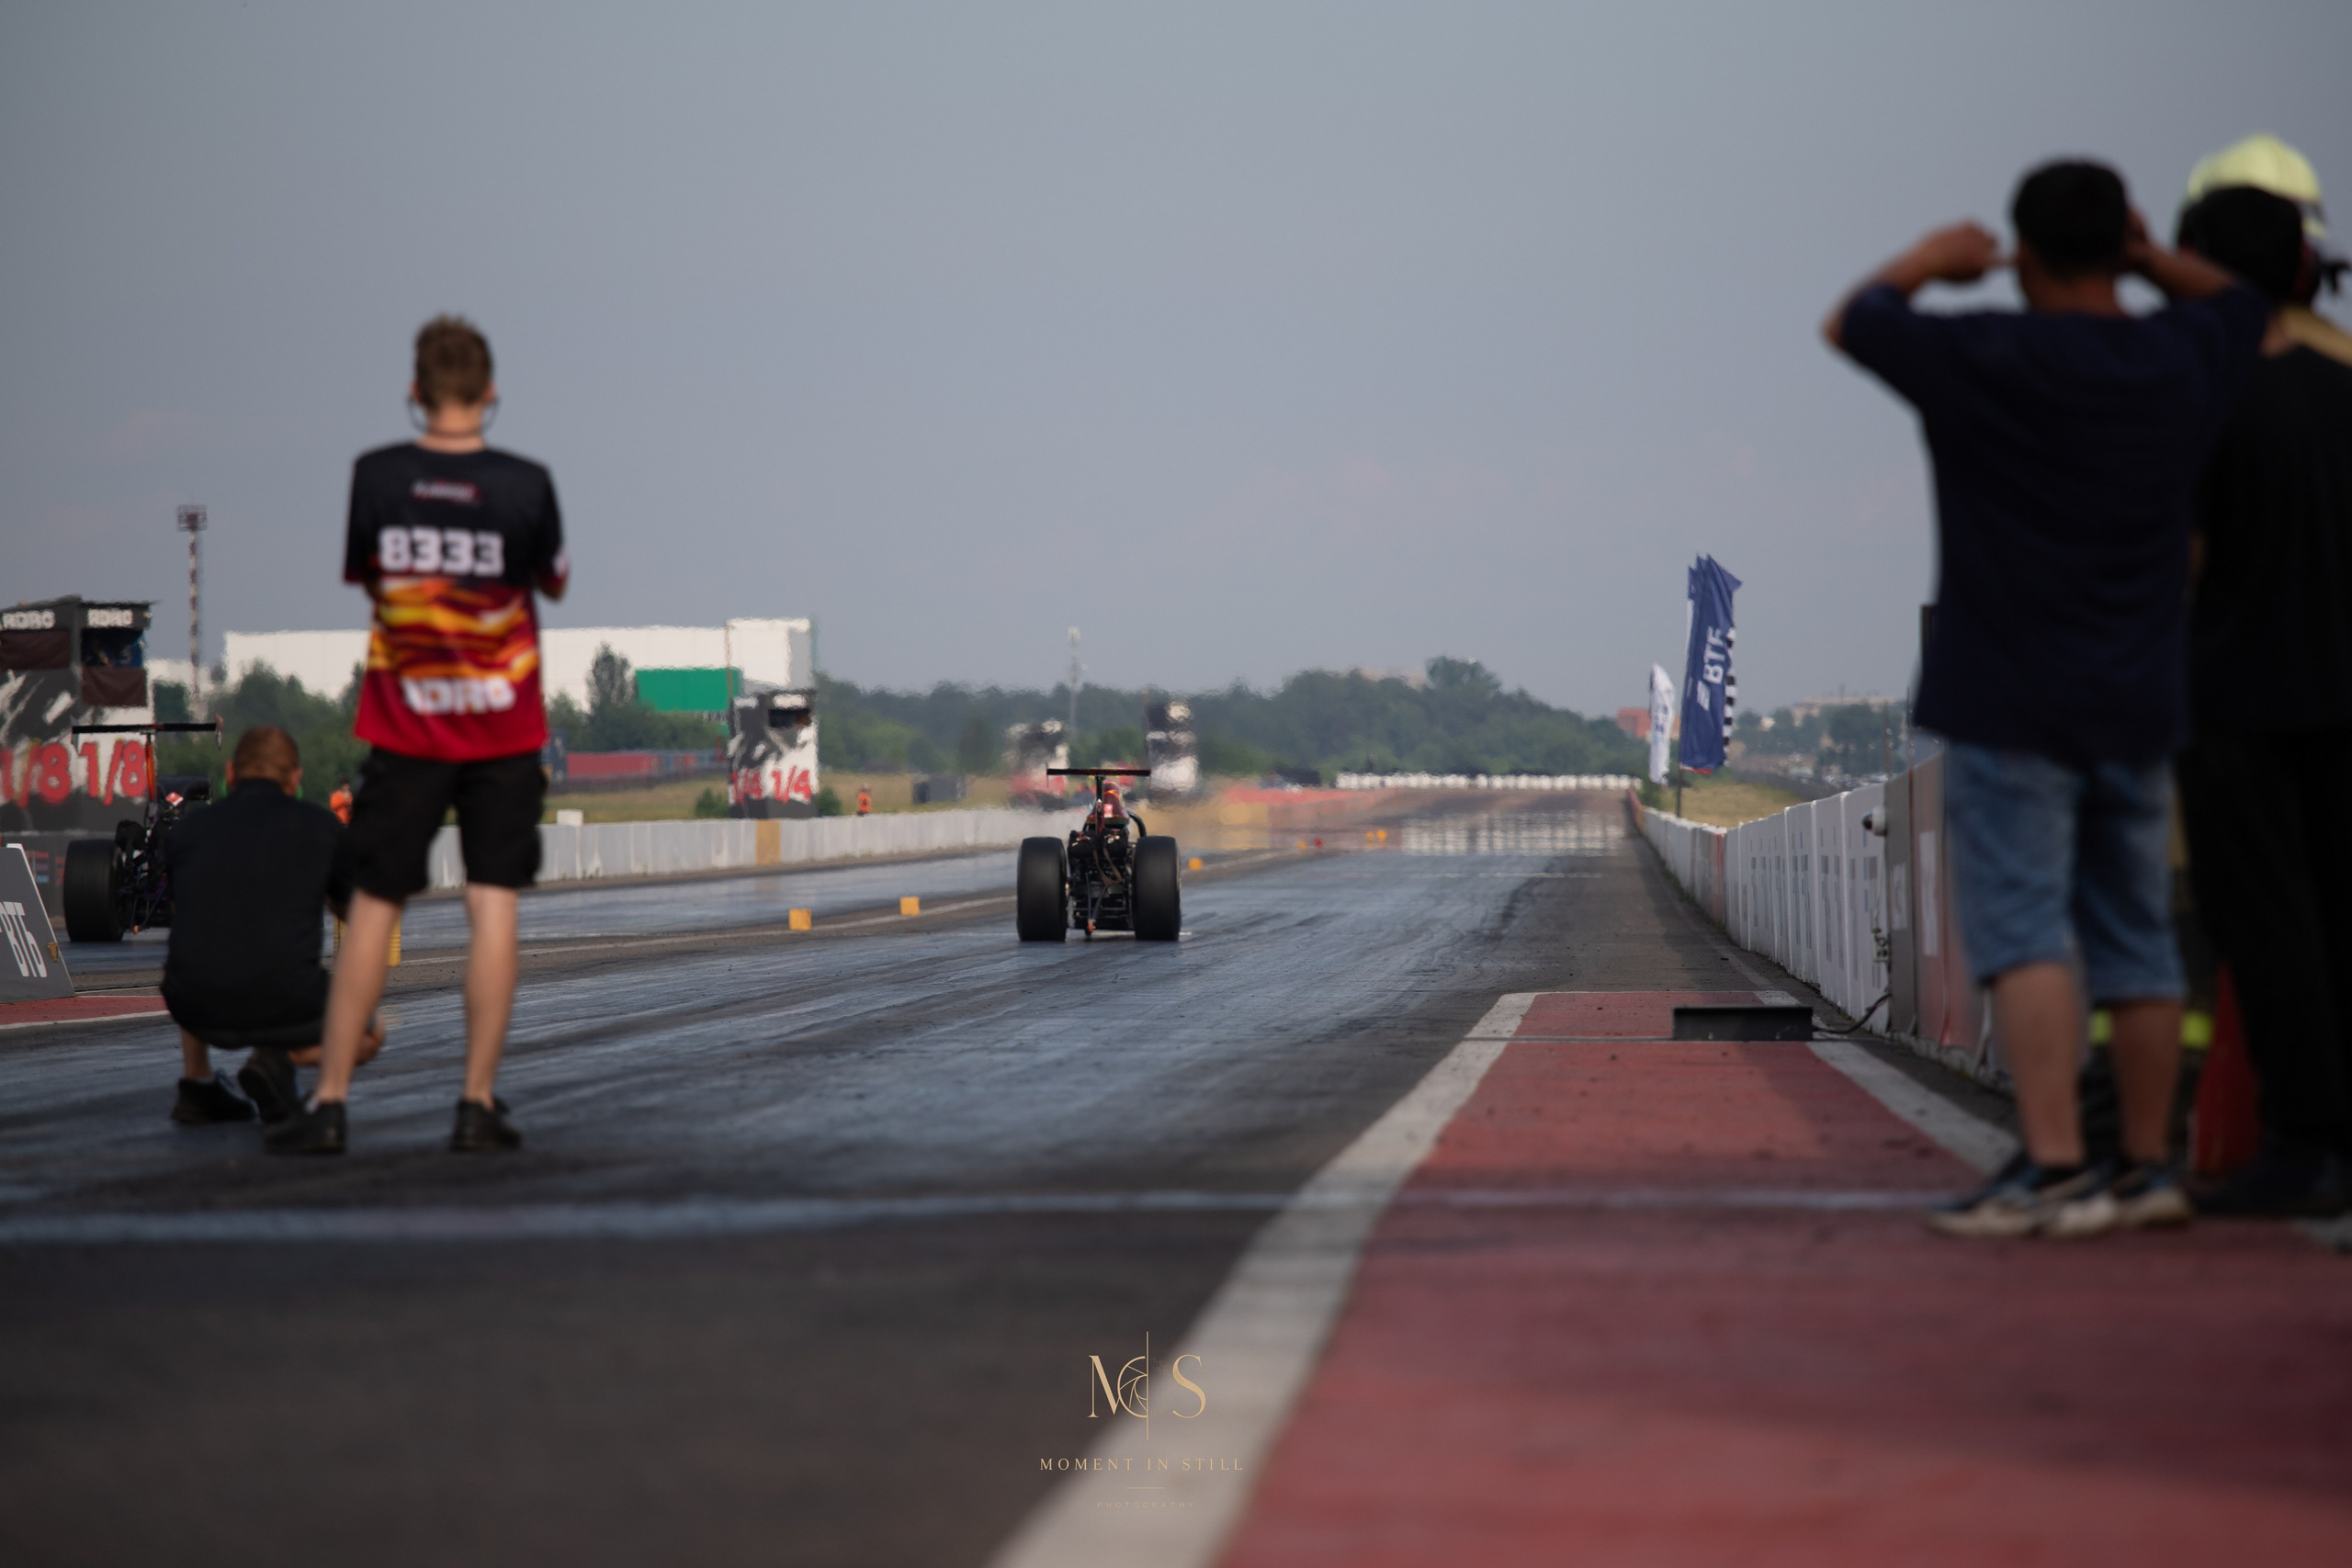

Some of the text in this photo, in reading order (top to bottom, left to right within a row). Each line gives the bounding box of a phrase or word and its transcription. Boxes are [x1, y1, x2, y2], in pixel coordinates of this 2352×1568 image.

[379, 526, 503, 576] 8333
[0, 739, 72, 808] 1/8
[79, 739, 148, 806] 1/8
[730, 767, 762, 805] 1/4
[771, 765, 811, 803] 1/4
